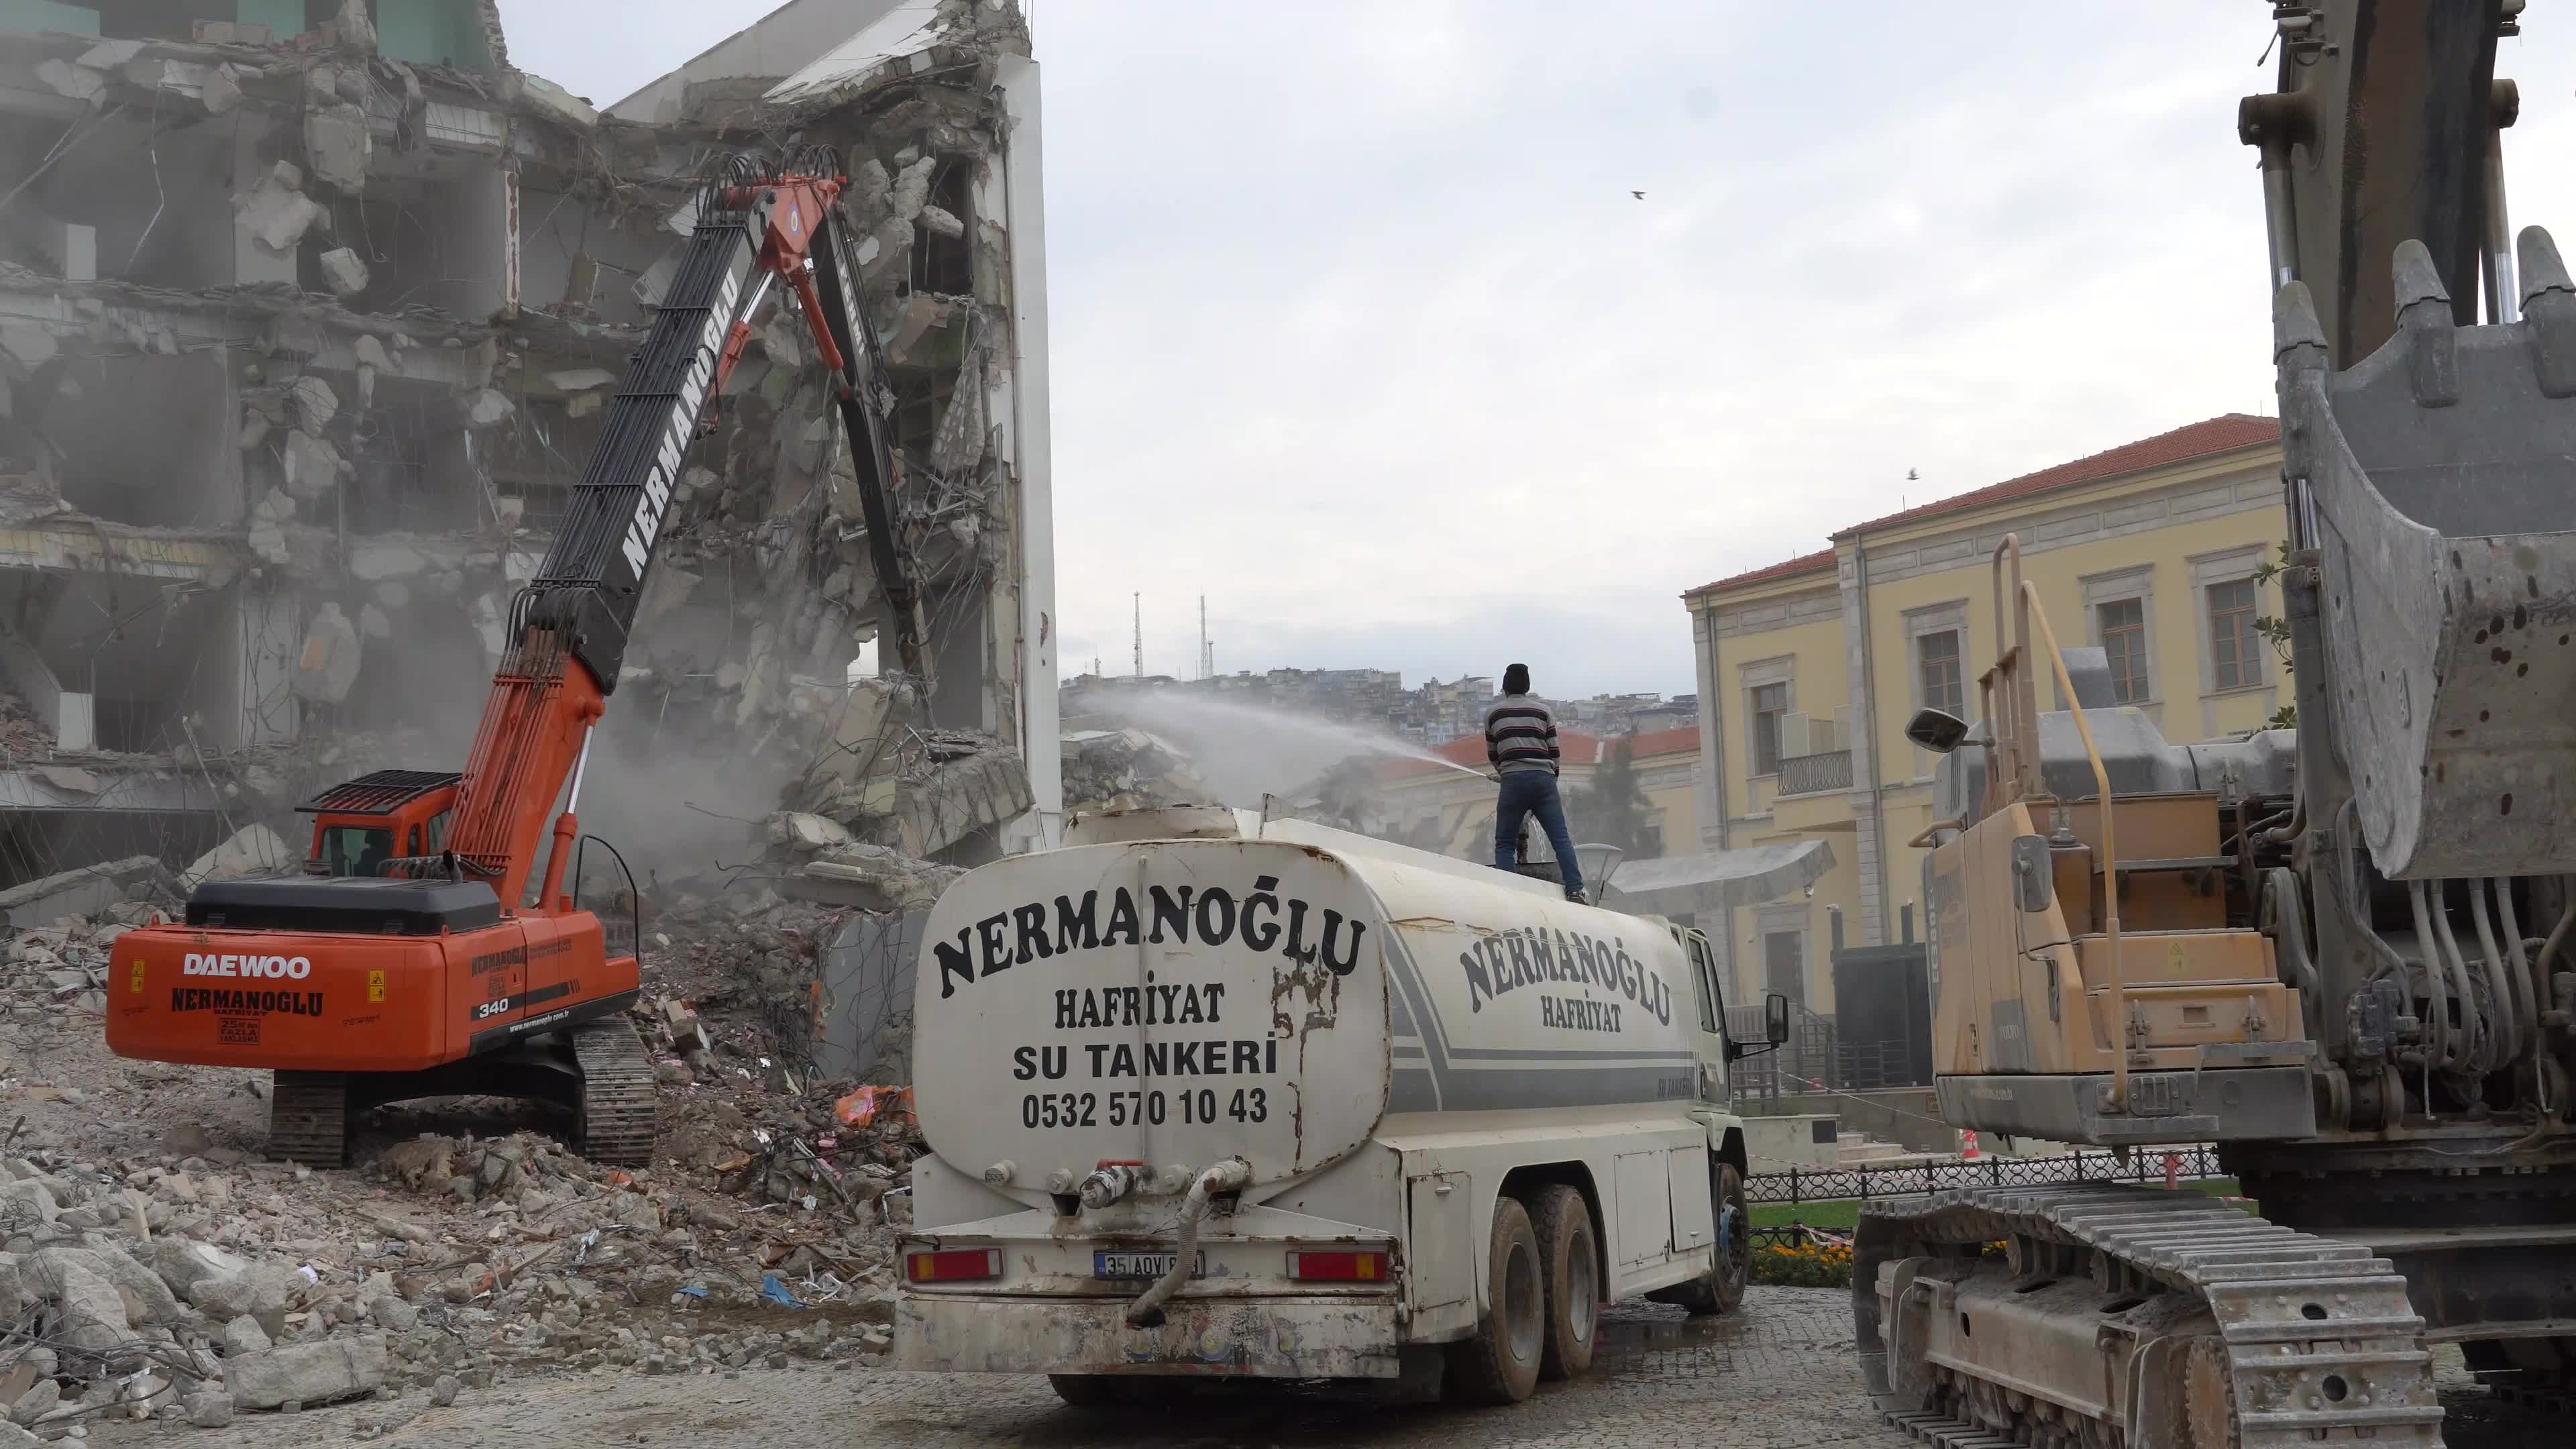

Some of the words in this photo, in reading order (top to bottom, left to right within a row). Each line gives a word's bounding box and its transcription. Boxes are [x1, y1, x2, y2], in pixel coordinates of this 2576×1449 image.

[933, 875, 1366, 999] NERMANOĞLU
[184, 953, 311, 979] DAEWOO
[1460, 926, 1670, 1026] NERMANOĞLU
[480, 998, 508, 1018] 340
[1055, 971, 1224, 1028] HAFRİYAT
[1540, 989, 1621, 1032] HAFRİYAT
[221, 1020, 237, 1028] 25
[1014, 1046, 1067, 1080] SU
[1085, 1031, 1276, 1077] TANKERİ
[1022, 1093, 1096, 1128] 0532
[1108, 1089, 1166, 1126] 570
[1179, 1089, 1216, 1124] 10
[1228, 1087, 1267, 1123] 43
[1107, 1257, 1126, 1274] 35
[1134, 1256, 1161, 1275] AOV
